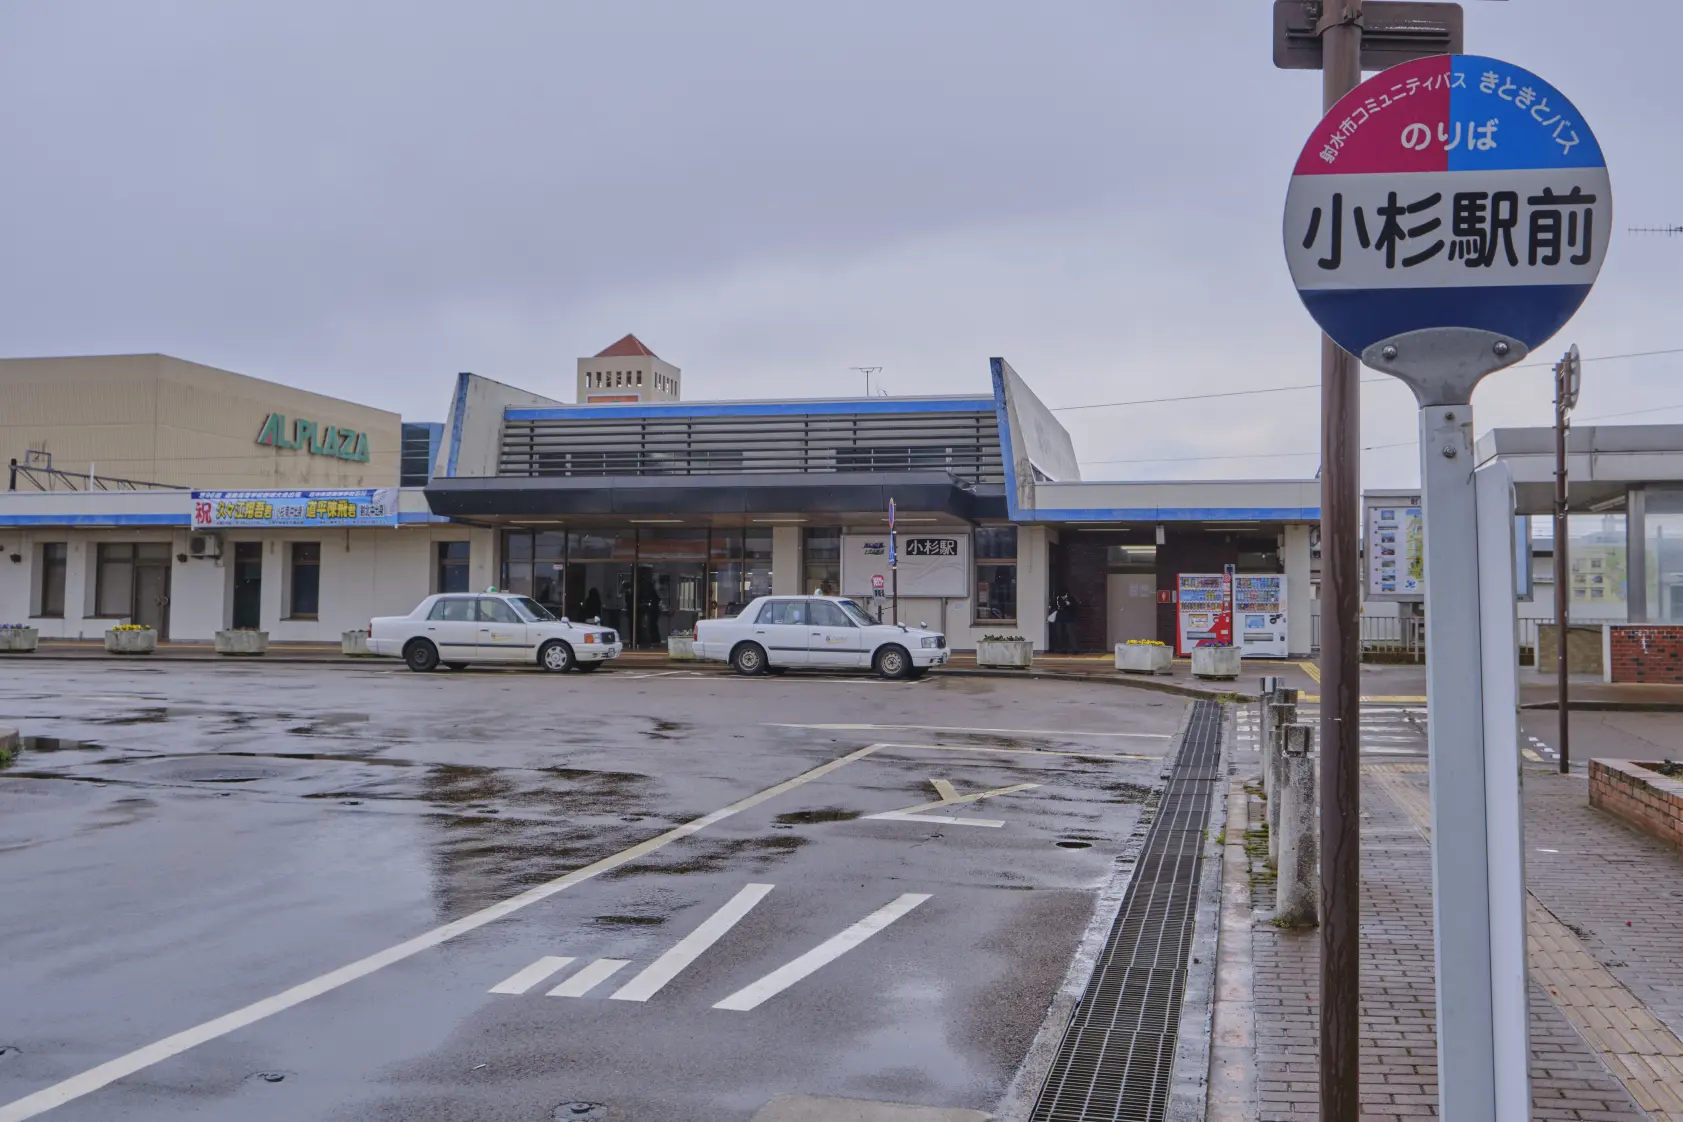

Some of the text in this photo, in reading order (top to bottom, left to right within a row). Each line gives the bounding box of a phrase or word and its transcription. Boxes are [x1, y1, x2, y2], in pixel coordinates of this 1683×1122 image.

[1319, 70, 1580, 164] 射水市コミュニティバス きときとバス
[1400, 118, 1499, 151] のりば
[1302, 185, 1597, 270] 小杉駅前
[194, 501, 212, 525] 祝
[907, 539, 955, 556] 小杉駅
